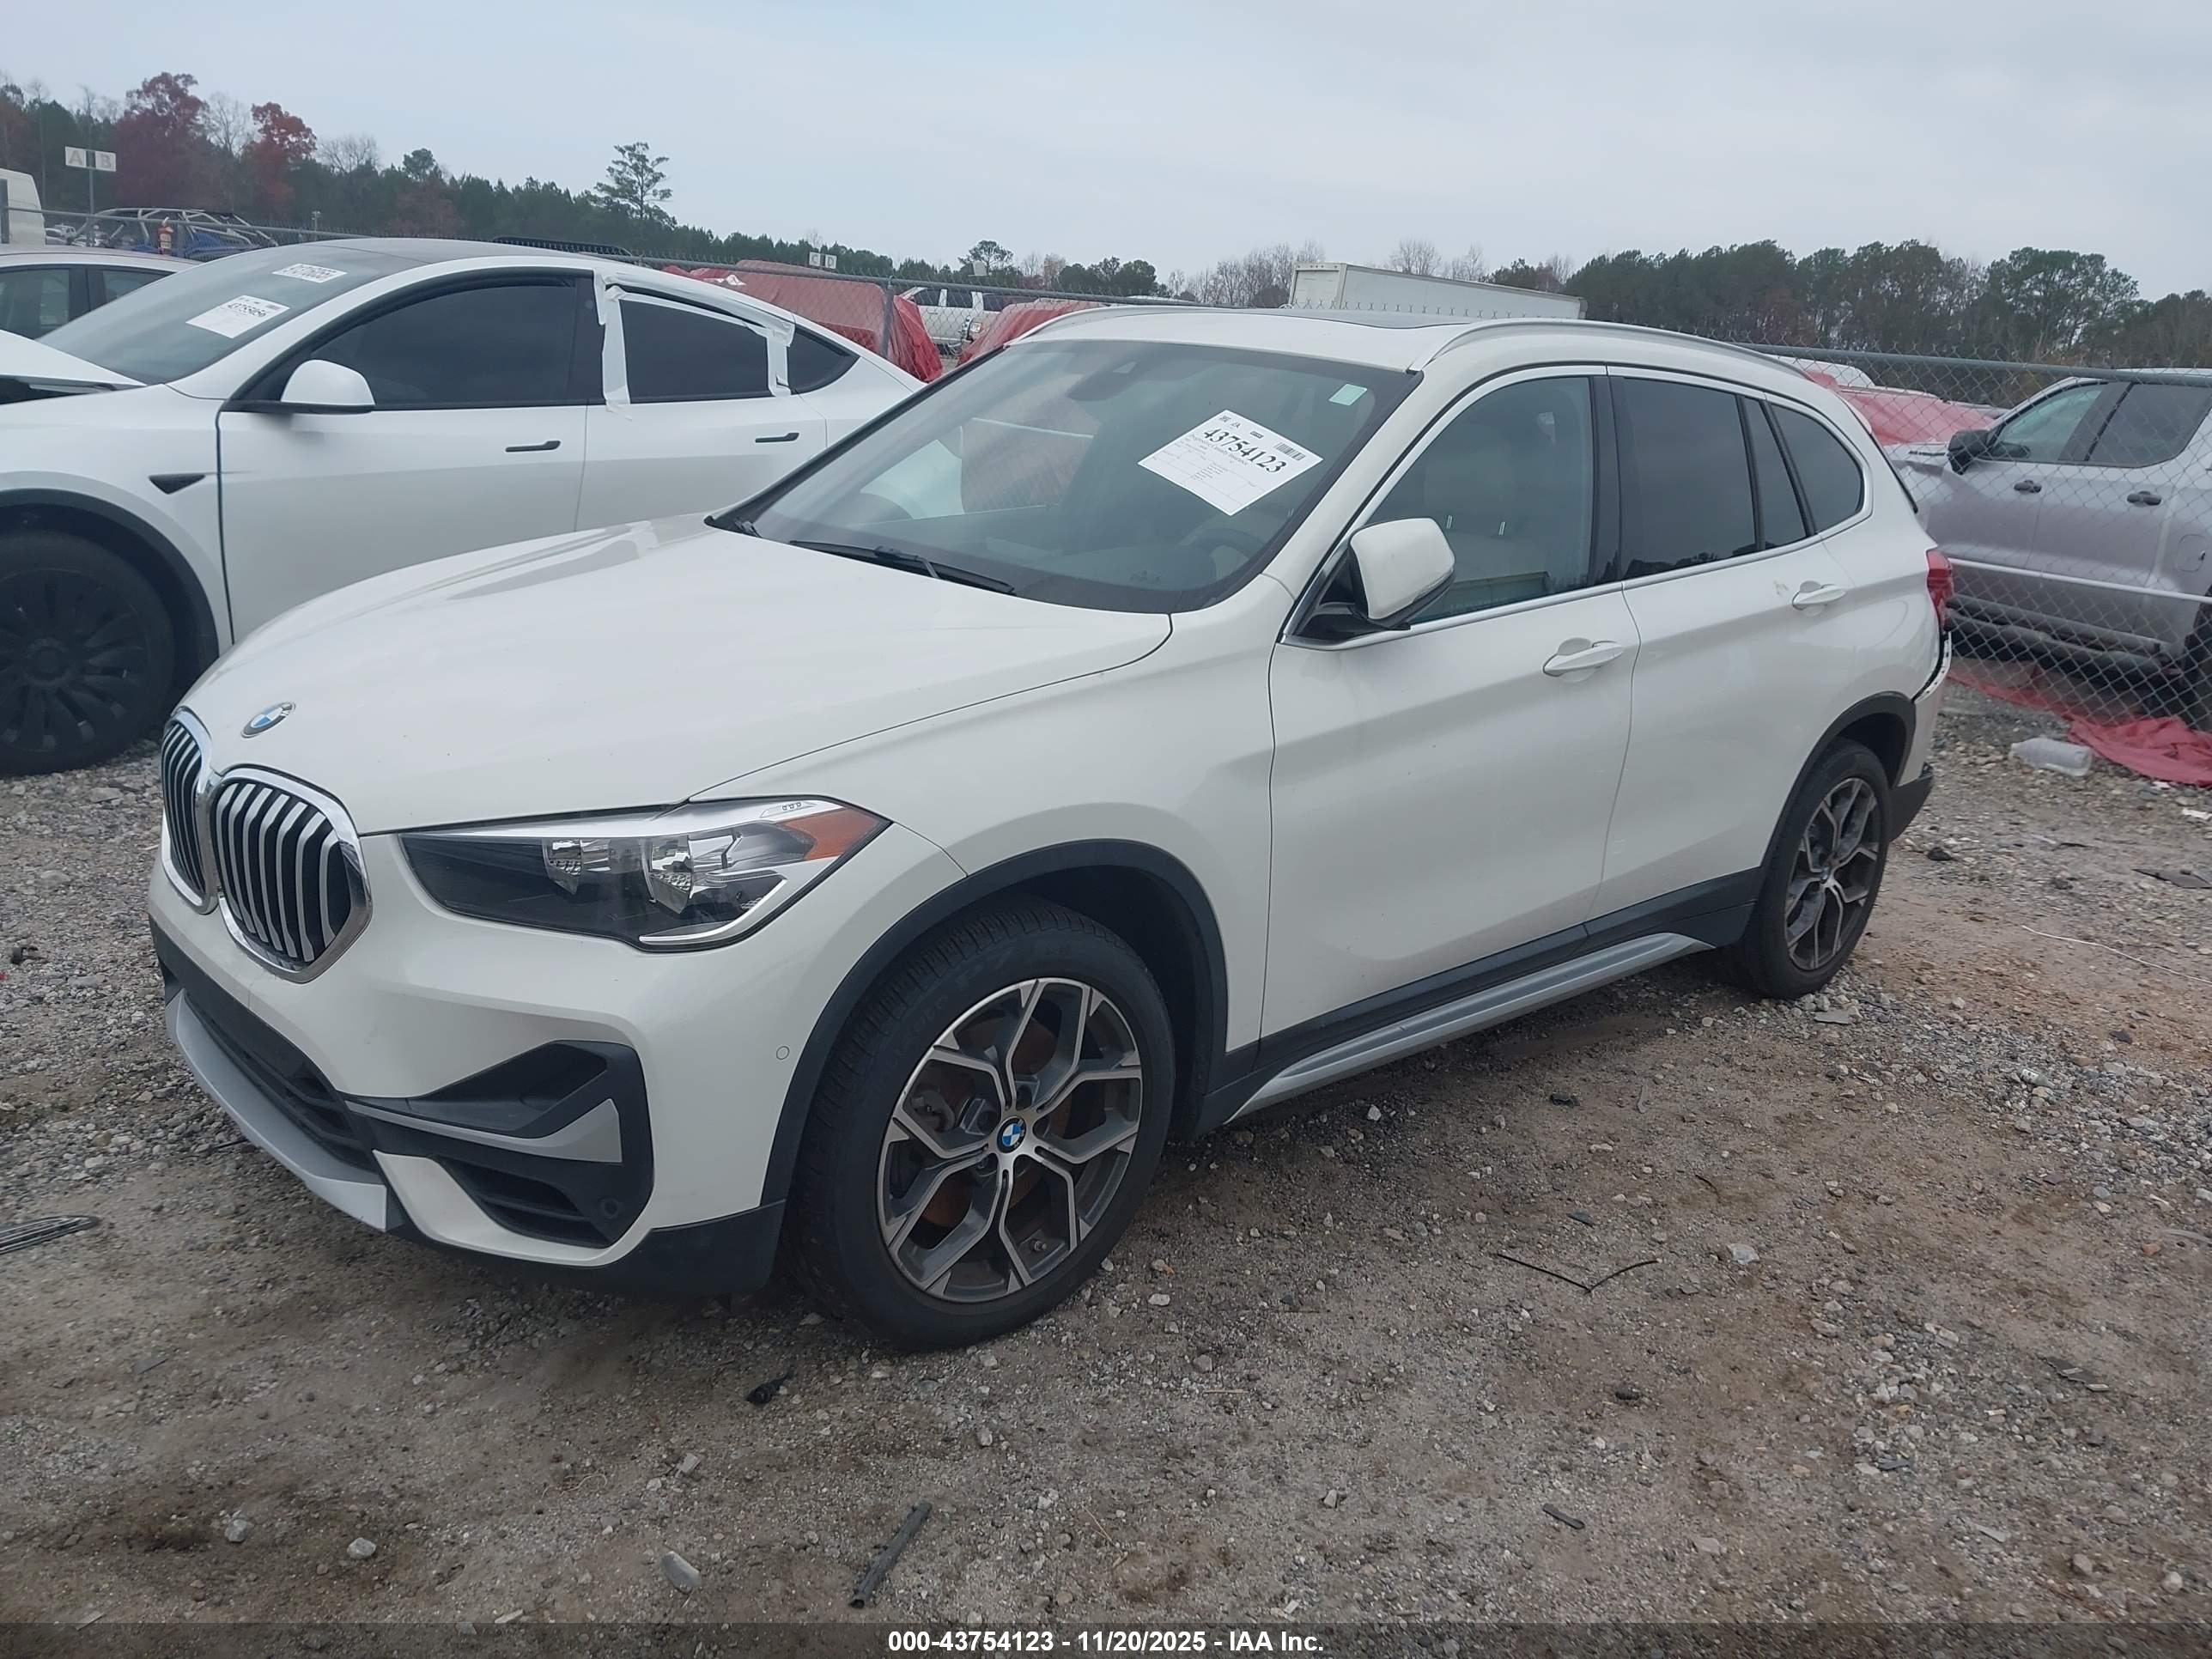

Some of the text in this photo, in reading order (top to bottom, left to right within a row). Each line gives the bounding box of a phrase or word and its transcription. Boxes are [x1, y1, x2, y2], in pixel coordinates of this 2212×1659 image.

[69, 150, 112, 168] A B
[811, 254, 835, 267] C D
[1204, 428, 1286, 473] 43754123
